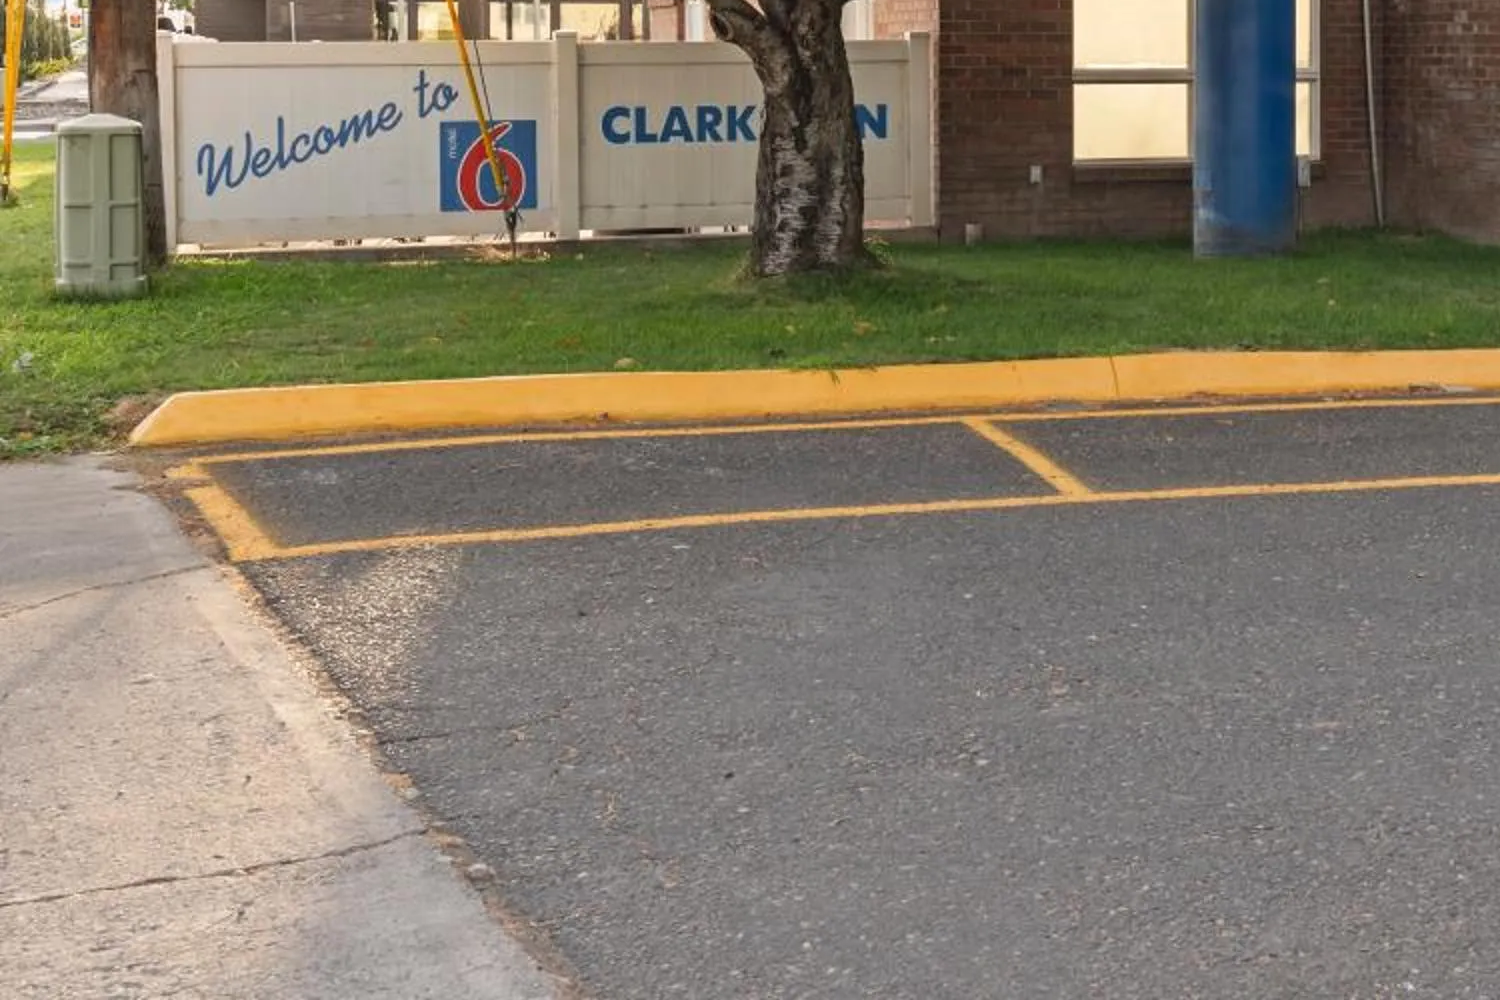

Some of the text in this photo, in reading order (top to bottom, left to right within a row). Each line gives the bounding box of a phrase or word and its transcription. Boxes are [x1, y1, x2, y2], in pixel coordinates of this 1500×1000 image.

[196, 68, 459, 197] Welcome to
[457, 121, 527, 213] 6
[600, 103, 888, 145] CLARKN
